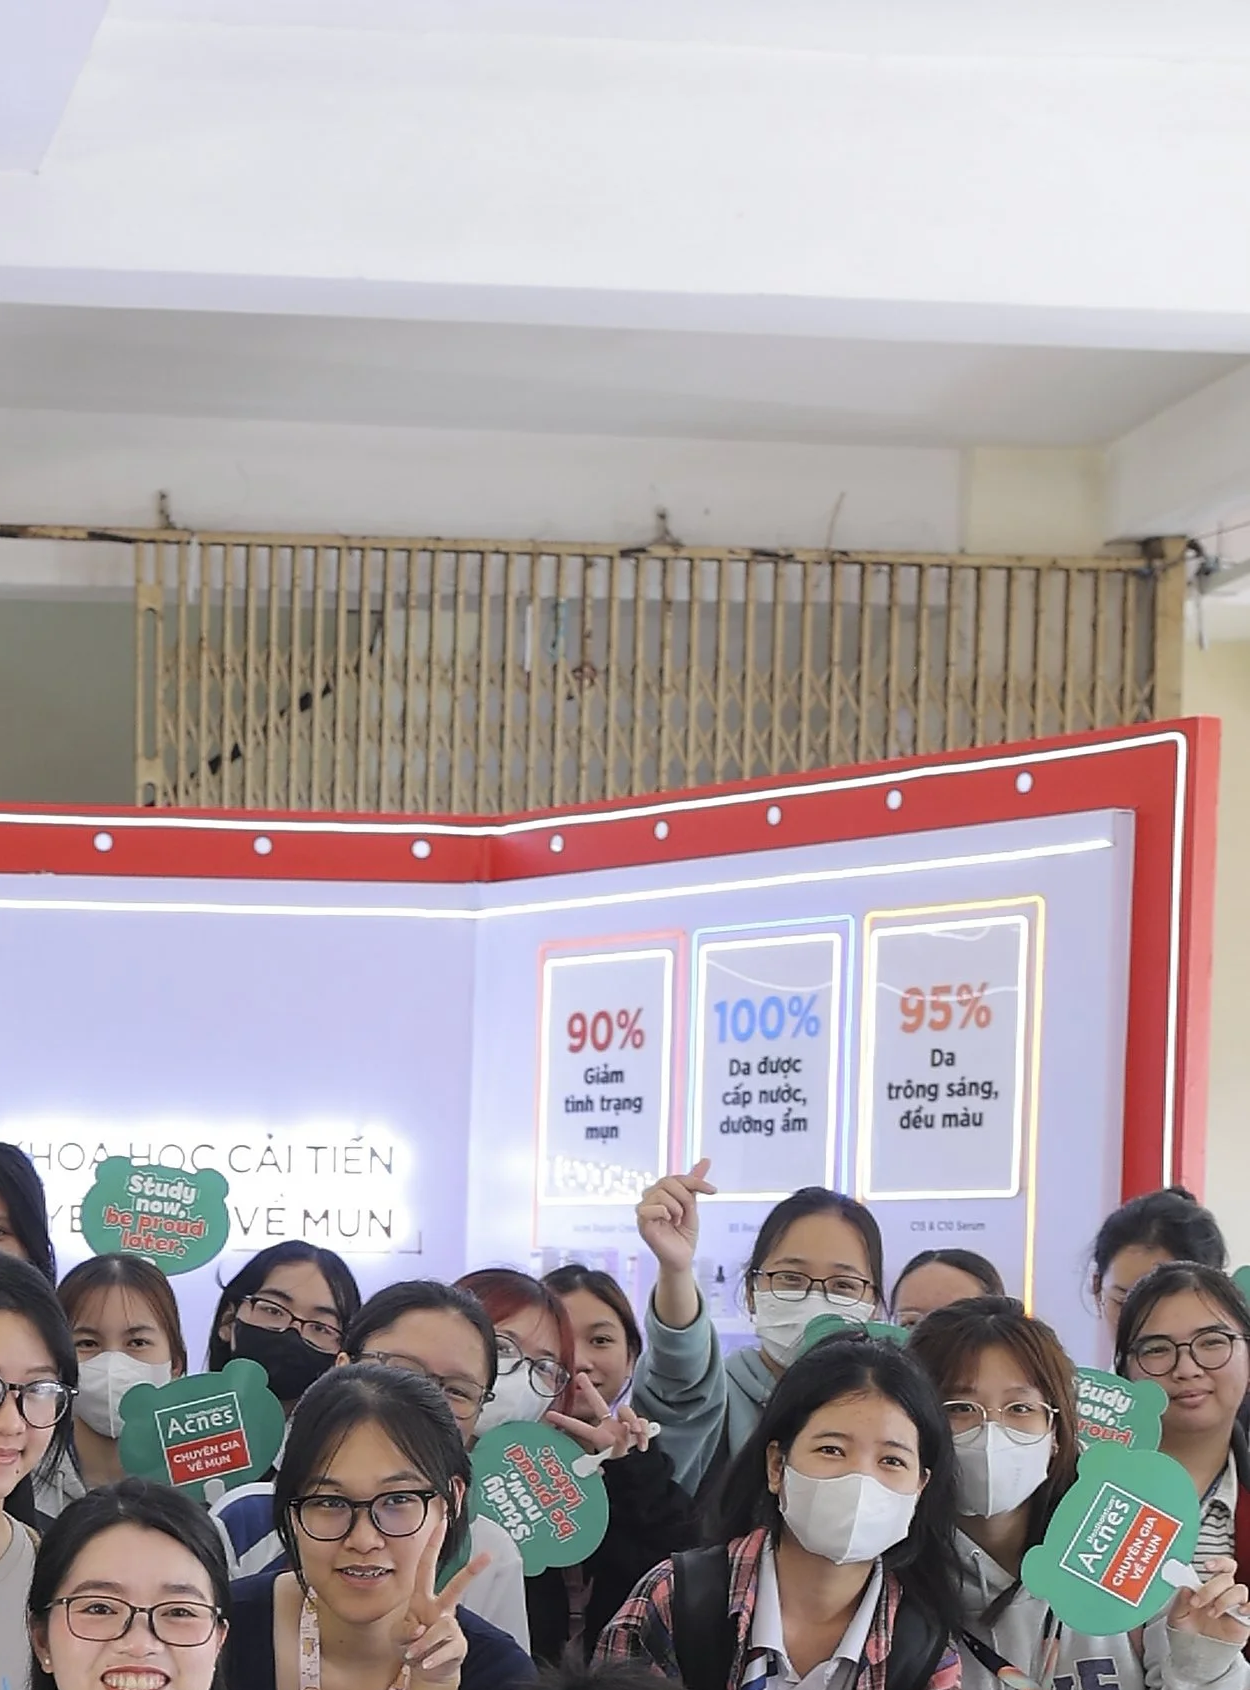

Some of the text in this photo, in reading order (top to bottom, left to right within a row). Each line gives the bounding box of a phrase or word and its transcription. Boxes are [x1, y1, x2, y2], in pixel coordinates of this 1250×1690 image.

[714, 994, 820, 1043] 100%
[900, 982, 992, 1033] 95%
[567, 1007, 644, 1053] 90%
[729, 1056, 802, 1079] Da được
[931, 1049, 955, 1067] Da
[584, 1064, 624, 1084] Giảm
[946, 1077, 998, 1099] sáng,
[601, 1096, 643, 1115] trạng
[722, 1082, 752, 1108] cấp
[720, 1107, 807, 1136] dưỡng ẩm
[942, 1108, 983, 1128] màu
[585, 1126, 618, 1144] mụn
[229, 1133, 291, 1173] CẢI
[306, 1136, 393, 1174] TIẾN
[128, 1173, 198, 1204] Study
[104, 1205, 133, 1227] be
[137, 1213, 205, 1239] proud
[135, 1197, 186, 1219] now,
[121, 1230, 186, 1256] later.
[168, 1409, 234, 1439] Acnes
[173, 1439, 241, 1463] CHUYÊN GIA
[504, 1444, 577, 1540] be proud
[540, 1446, 585, 1511] later.
[483, 1475, 531, 1542] Study
[506, 1473, 543, 1521] now,
[1078, 1499, 1130, 1574] Acnes
[1112, 1516, 1158, 1587] CHUYÊN GIA
